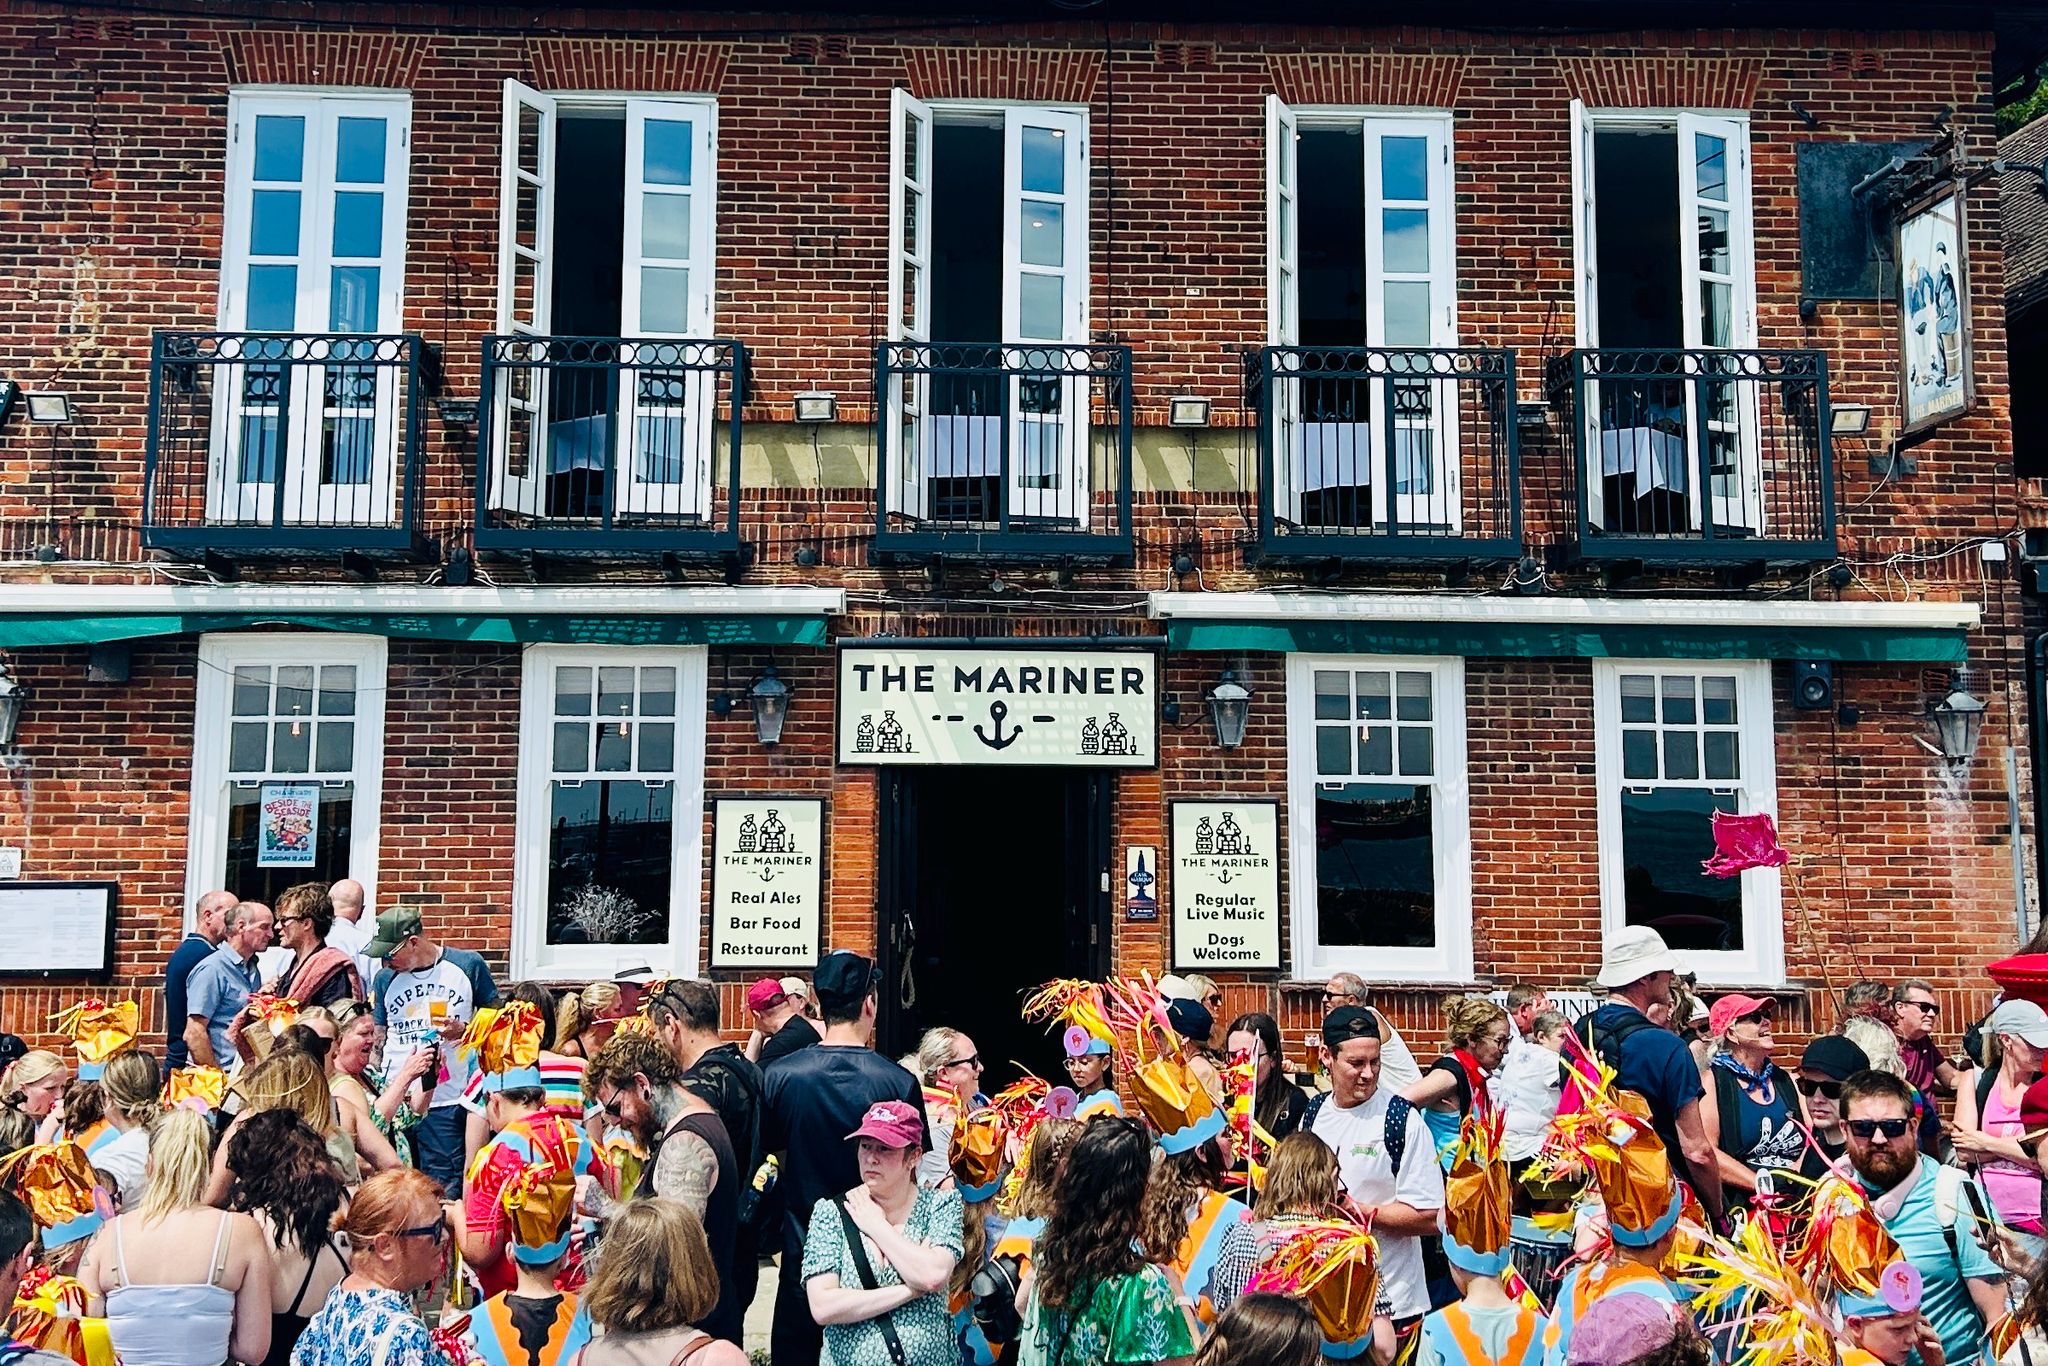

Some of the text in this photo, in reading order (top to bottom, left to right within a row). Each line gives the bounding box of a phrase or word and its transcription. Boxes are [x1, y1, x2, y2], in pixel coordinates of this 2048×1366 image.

[852, 664, 1145, 696] THE MARINER
[264, 799, 313, 814] BESIDE THE
[273, 807, 311, 819] SEASIDE
[723, 856, 813, 866] THE MARINER
[1181, 858, 1269, 868] THE MARINER
[731, 891, 801, 905] Real Ales
[1195, 893, 1256, 908] Regular
[1186, 907, 1266, 920] Live Music
[730, 916, 801, 930] Bar Food
[1208, 933, 1245, 948] Dogs
[721, 942, 809, 955] Restaurant
[1192, 947, 1261, 960] Welcome
